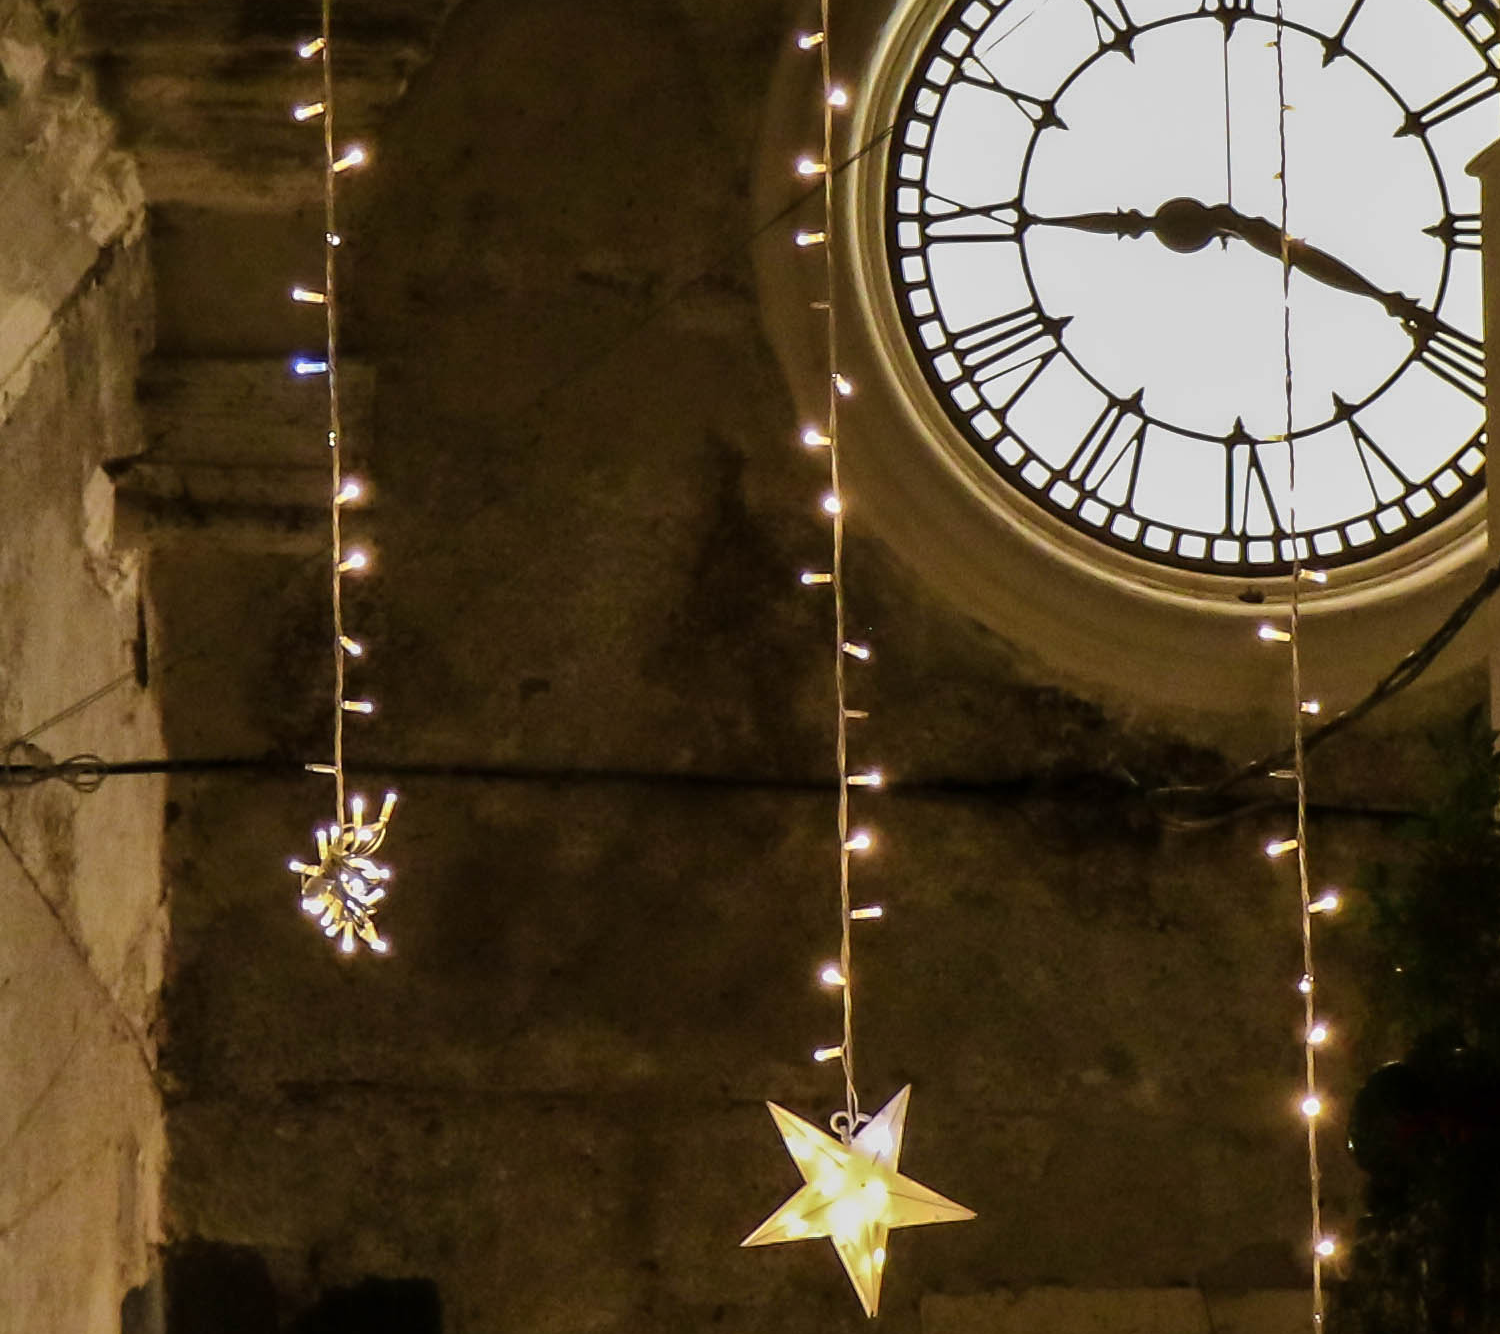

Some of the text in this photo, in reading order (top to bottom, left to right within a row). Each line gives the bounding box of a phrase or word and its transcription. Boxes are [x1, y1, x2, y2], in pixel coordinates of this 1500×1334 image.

[957, 56, 1050, 125] X
[922, 191, 1024, 243] IX
[951, 307, 1060, 413] VIII
[1067, 403, 1148, 511] VII
[1225, 441, 1288, 537] VI
[1348, 415, 1418, 507] V
